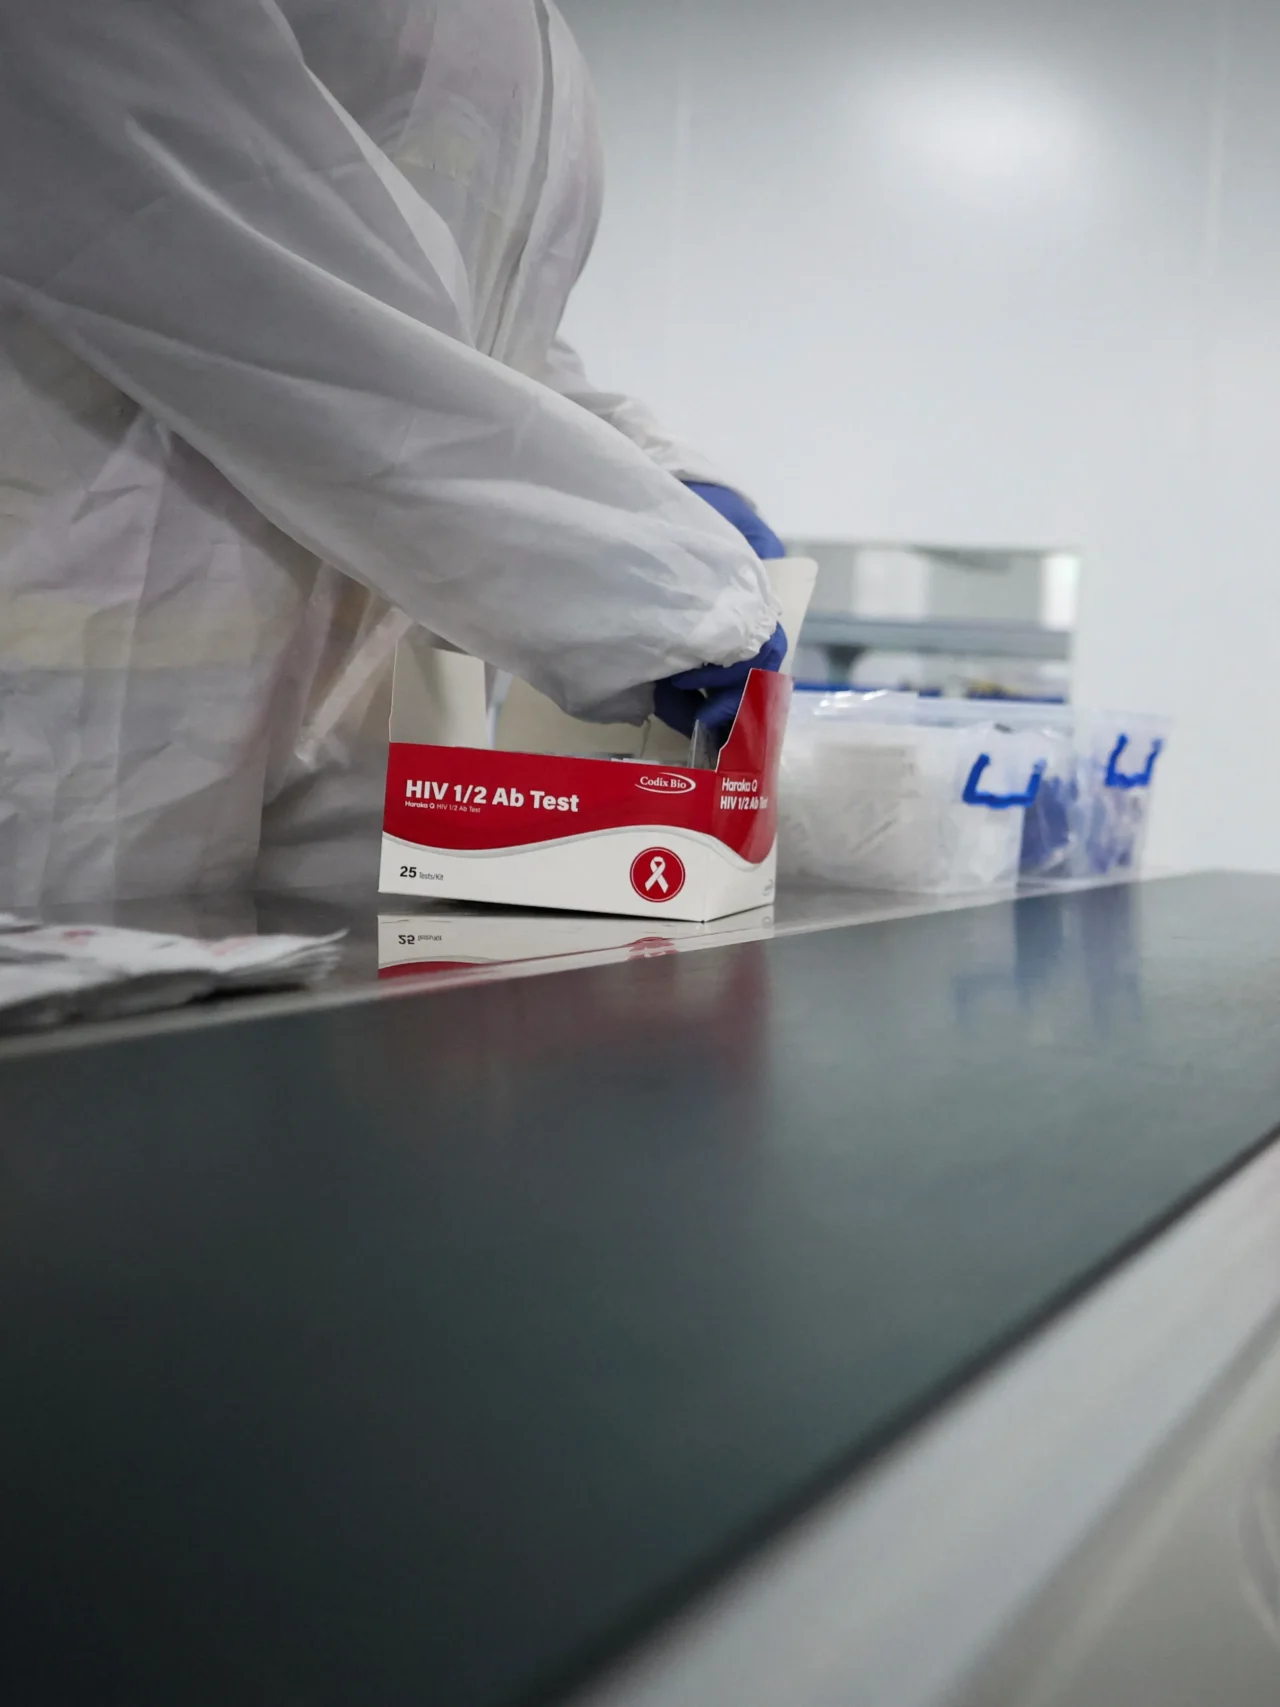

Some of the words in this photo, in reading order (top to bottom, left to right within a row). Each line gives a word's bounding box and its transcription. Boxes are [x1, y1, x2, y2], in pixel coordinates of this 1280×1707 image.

[640, 776, 668, 787] Codix
[670, 779, 687, 789] Bio
[722, 777, 751, 792] Haraka
[751, 779, 758, 792] Q
[405, 779, 449, 800] HIV
[453, 784, 487, 804] 1/2
[492, 787, 524, 807] Ab
[530, 790, 579, 812] Test
[720, 795, 737, 810] HIV
[738, 796, 750, 810] 1/2
[749, 796, 759, 810] Ab
[405, 800, 428, 809] Haraka
[437, 803, 448, 811] HIV
[449, 804, 458, 812] 1/2
[399, 866, 417, 878] 25
[419, 872, 444, 881] Tests/Kit
